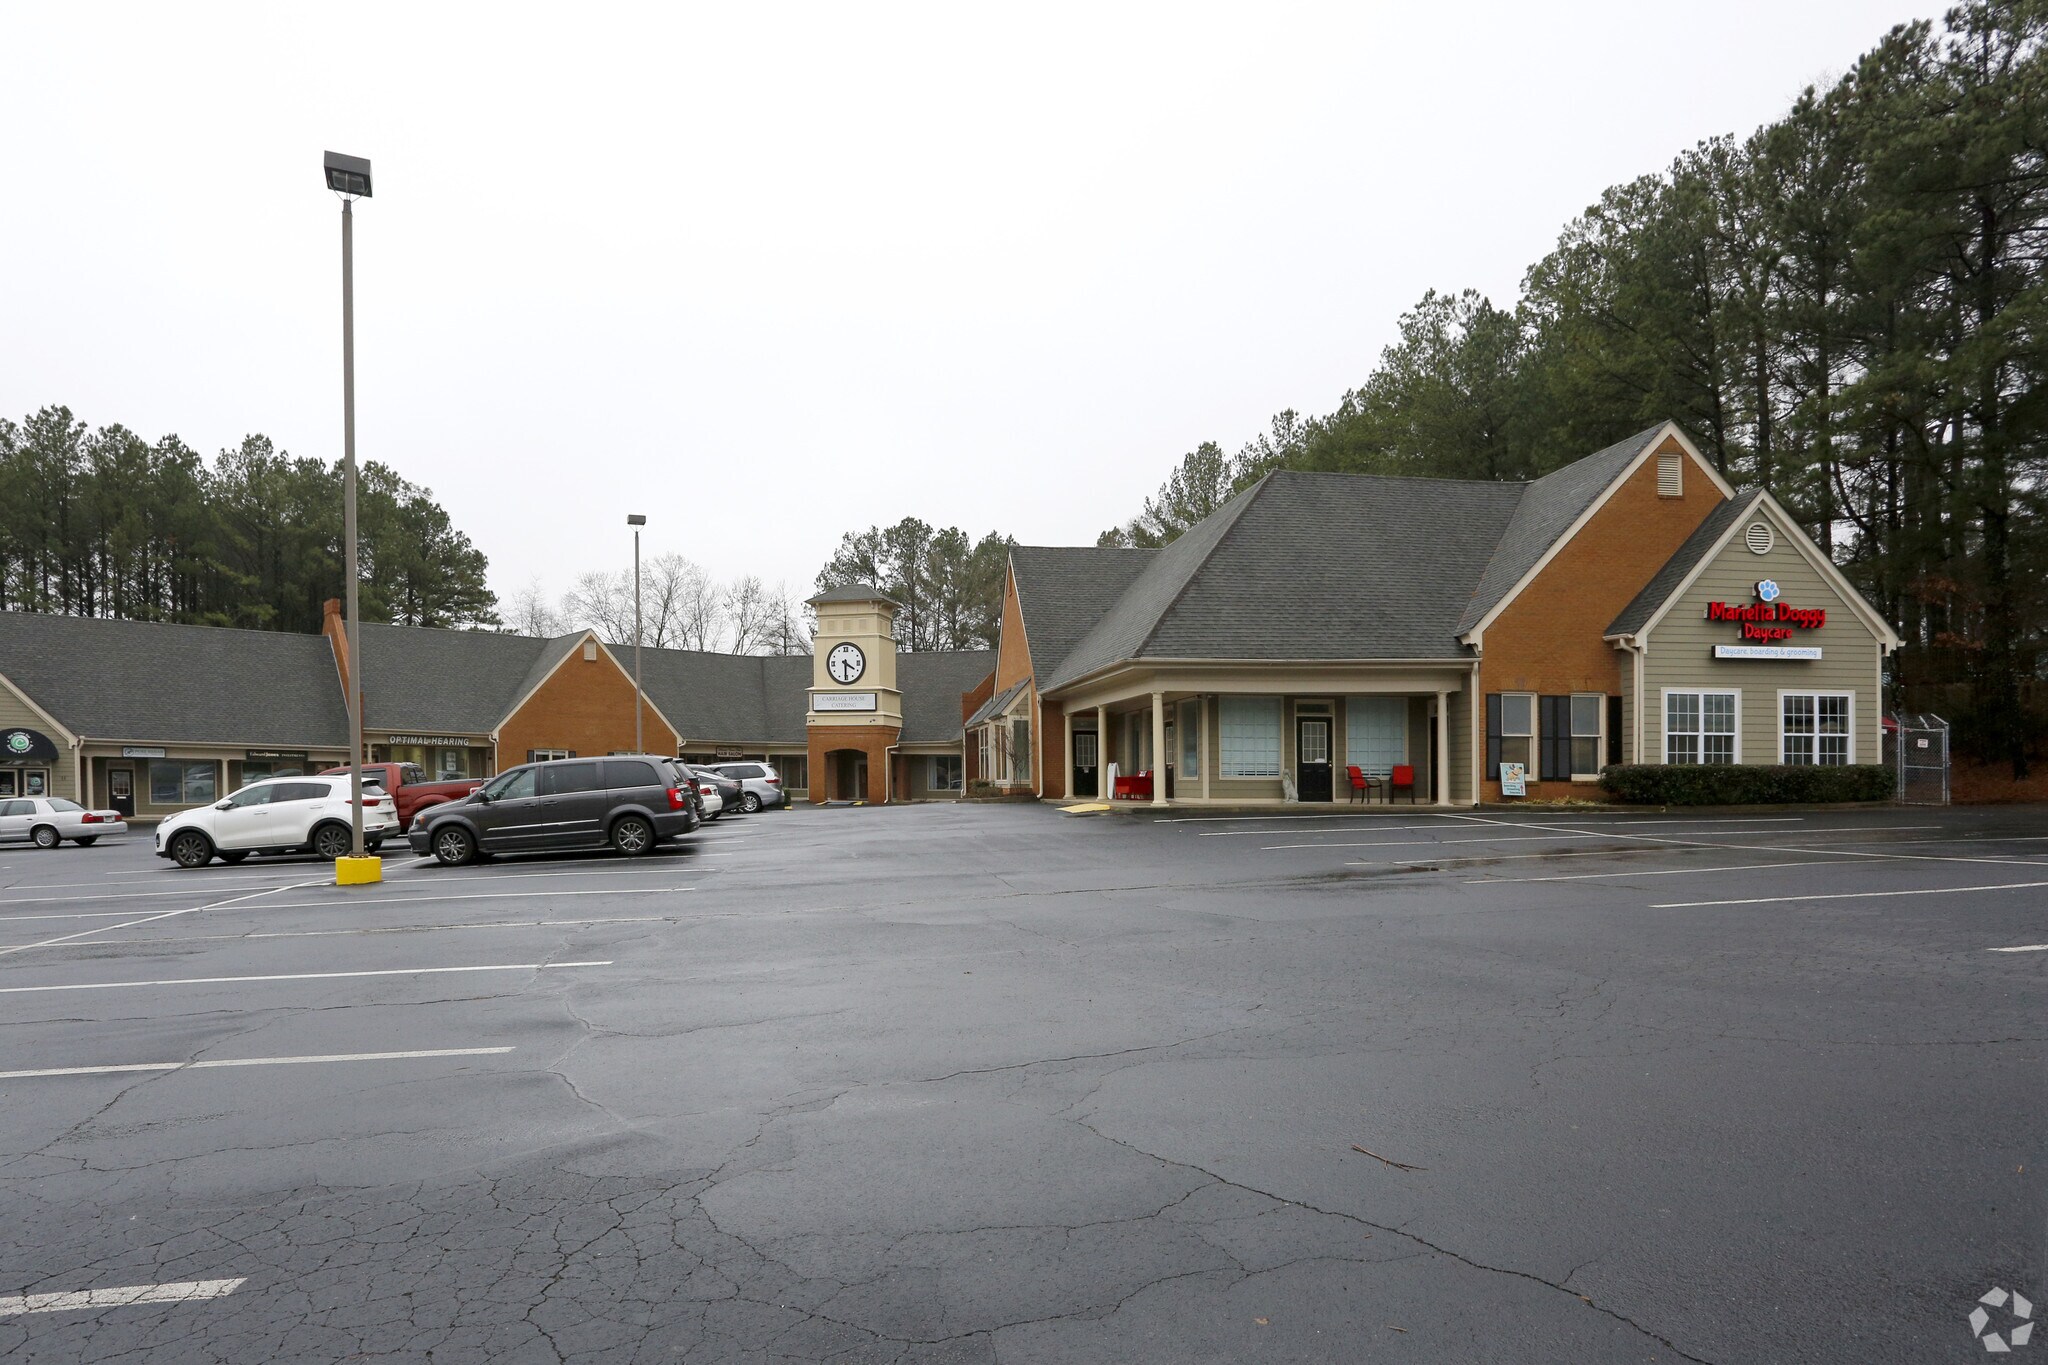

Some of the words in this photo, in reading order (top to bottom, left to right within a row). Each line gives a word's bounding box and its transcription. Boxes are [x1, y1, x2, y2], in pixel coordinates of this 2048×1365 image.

[1710, 601, 1774, 620] Marietta
[1778, 602, 1825, 628] Doggy
[1744, 623, 1793, 644] Daycare
[1750, 648, 1778, 657] boarding
[1787, 649, 1818, 658] grooming
[389, 735, 430, 745] OPTIMAL
[431, 737, 470, 746] HEARING
